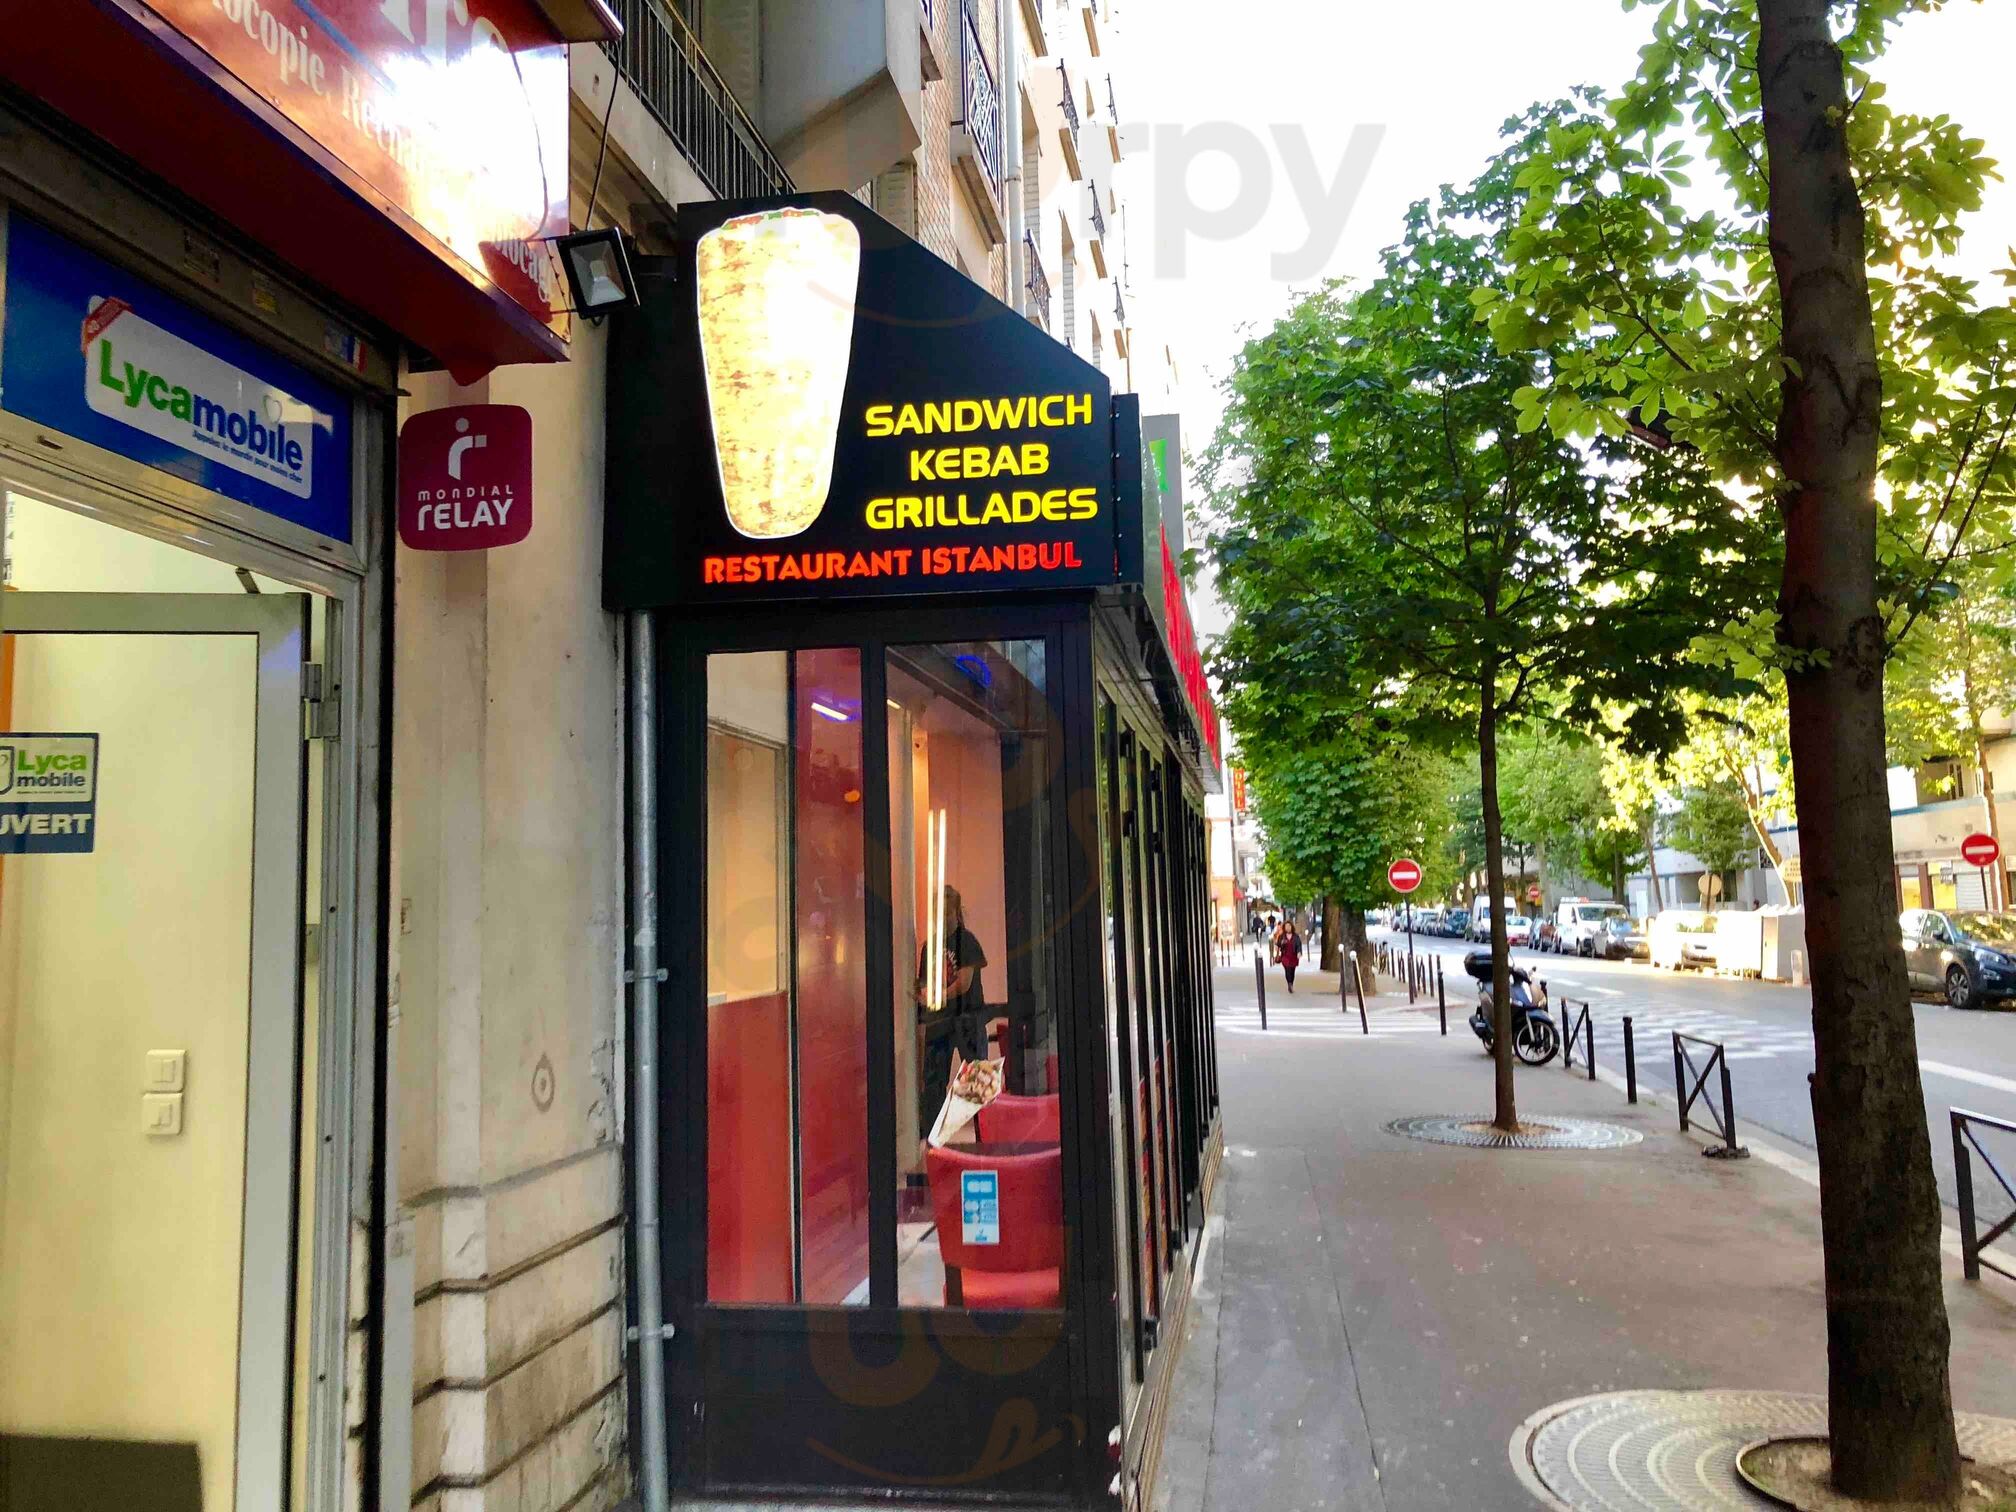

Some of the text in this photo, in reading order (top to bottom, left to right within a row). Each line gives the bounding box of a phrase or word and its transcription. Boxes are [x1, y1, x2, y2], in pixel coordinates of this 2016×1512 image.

[100, 338, 304, 471] Lycamobile
[865, 393, 1093, 437] SANDWICH
[910, 443, 1050, 481] KEBAB
[865, 488, 1099, 530] GRILLADES
[704, 542, 1082, 584] RESTAURANT ISTANBUL
[17, 750, 87, 775] Lyca
[17, 772, 86, 787] mobile
